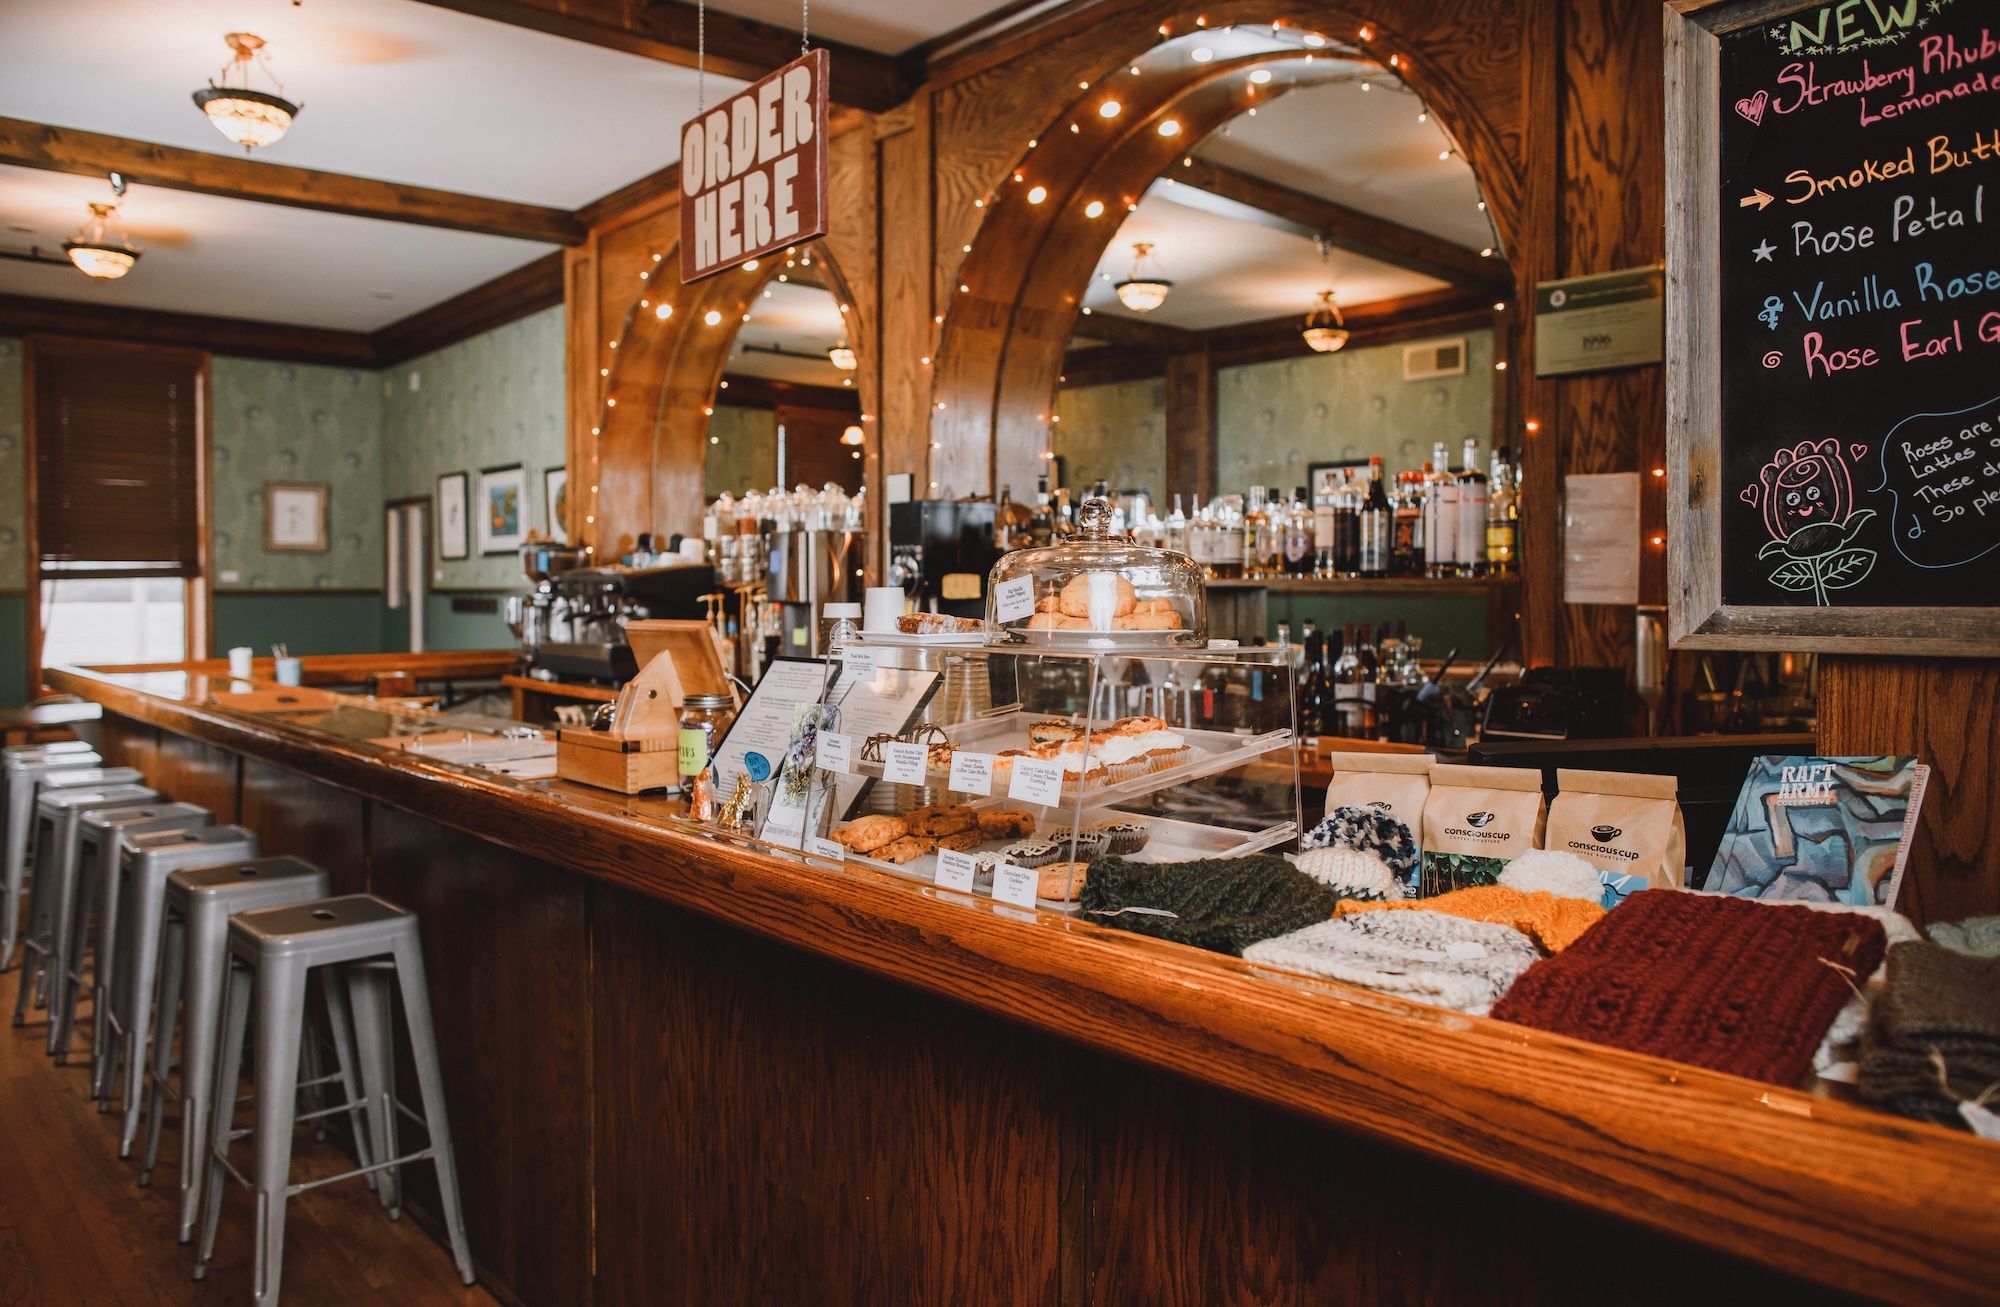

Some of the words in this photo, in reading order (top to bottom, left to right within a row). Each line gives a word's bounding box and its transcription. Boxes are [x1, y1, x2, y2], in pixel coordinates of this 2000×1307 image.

[1789, 0, 1918, 51] NEW
[1772, 60, 1915, 115] Strawberry
[1919, 28, 2000, 75] Rhub
[1859, 73, 2000, 127] Lemonade
[682, 65, 814, 197] ORDER
[1785, 146, 1915, 205] Smoked
[694, 153, 799, 272] HERE
[1791, 220, 1875, 257] Rose
[1892, 184, 1984, 243] Petal
[1792, 275, 1902, 323] Vanilla
[1914, 262, 2000, 302] Rose
[1803, 331, 1881, 379] Rose
[1900, 319, 1963, 362] Earl
[1901, 436, 1954, 463] Roses
[1960, 421, 1993, 442] are
[1909, 447, 1977, 479] Lattes
[1912, 475, 1975, 504] These
[1932, 504, 1966, 523] So
[1029, 777, 1046, 786] Frosting
[1777, 781, 1836, 799] ARMY
[1781, 764, 1836, 783] RAFT
[1776, 798, 1831, 806] COLLECTIVE
[1003, 869, 1021, 877] Chocolate
[1008, 876, 1023, 884] Cookies
